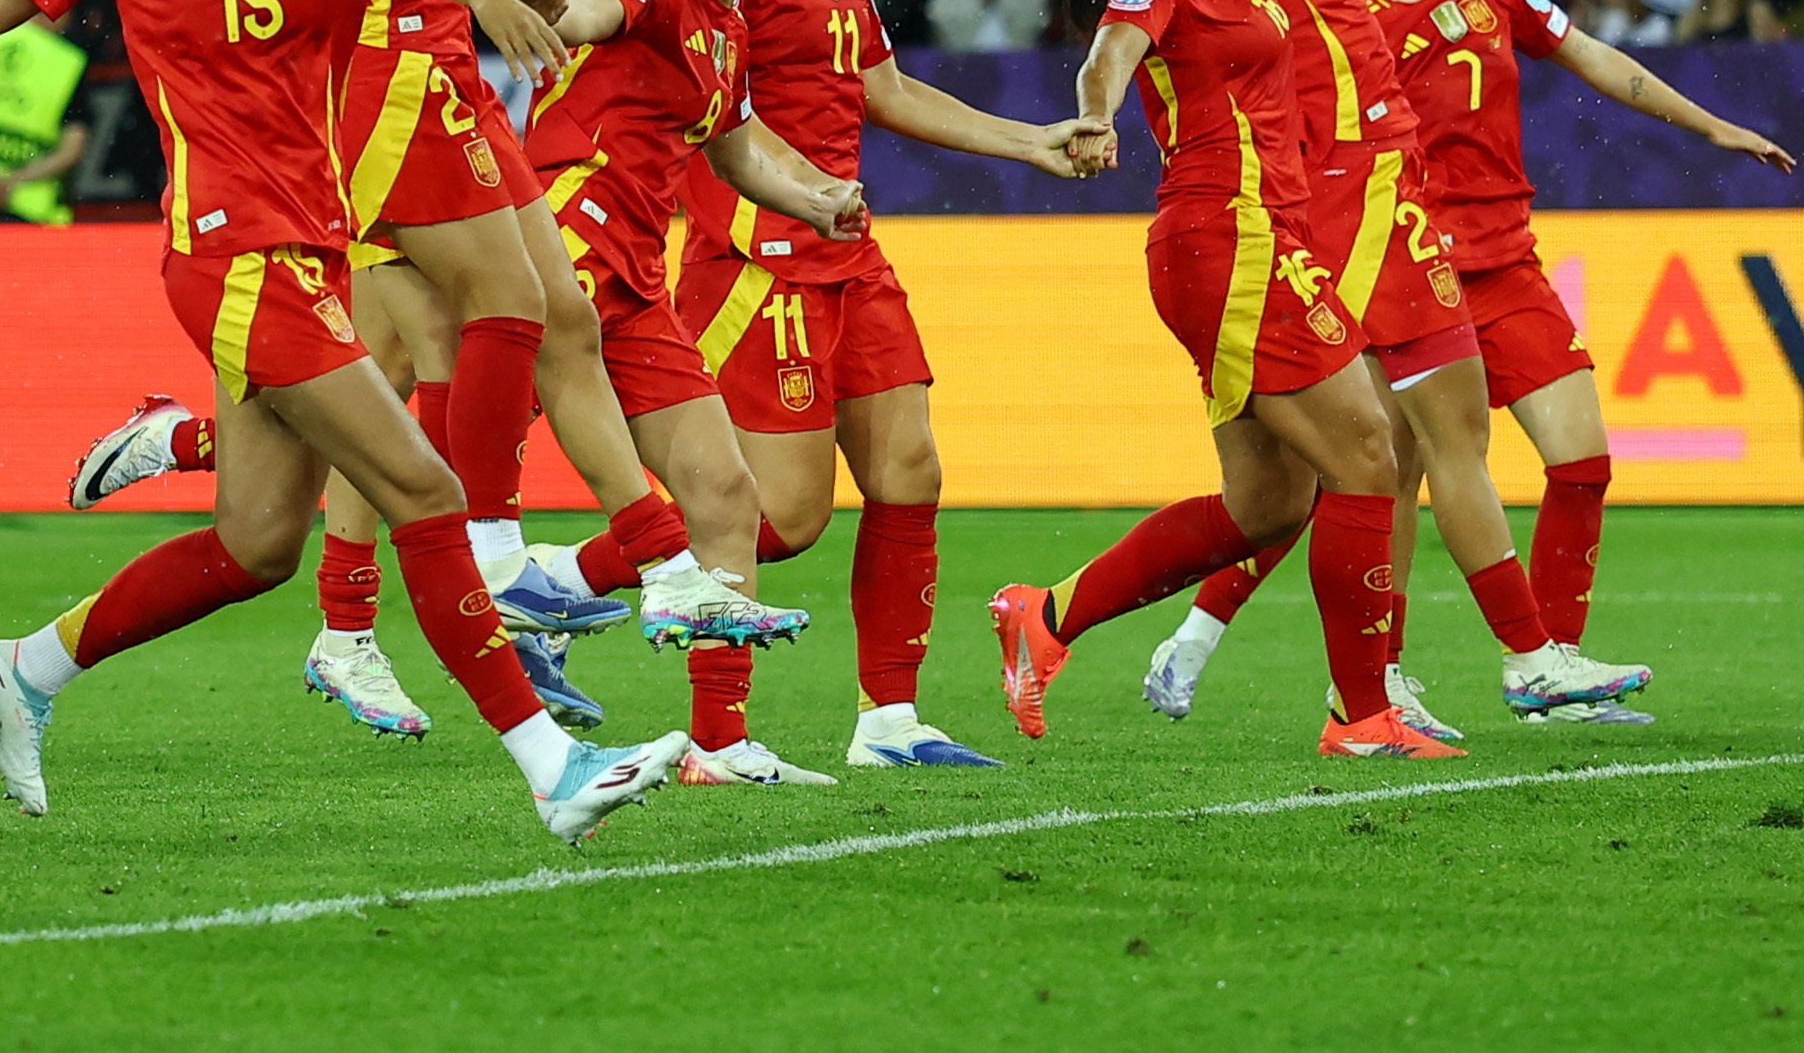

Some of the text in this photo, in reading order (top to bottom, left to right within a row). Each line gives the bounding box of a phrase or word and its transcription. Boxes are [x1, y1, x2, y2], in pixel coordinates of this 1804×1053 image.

[826, 9, 861, 75] 11
[1446, 48, 1483, 112] 7
[683, 89, 723, 145] 8
[1275, 249, 1333, 307] 16
[762, 293, 812, 361] 11
